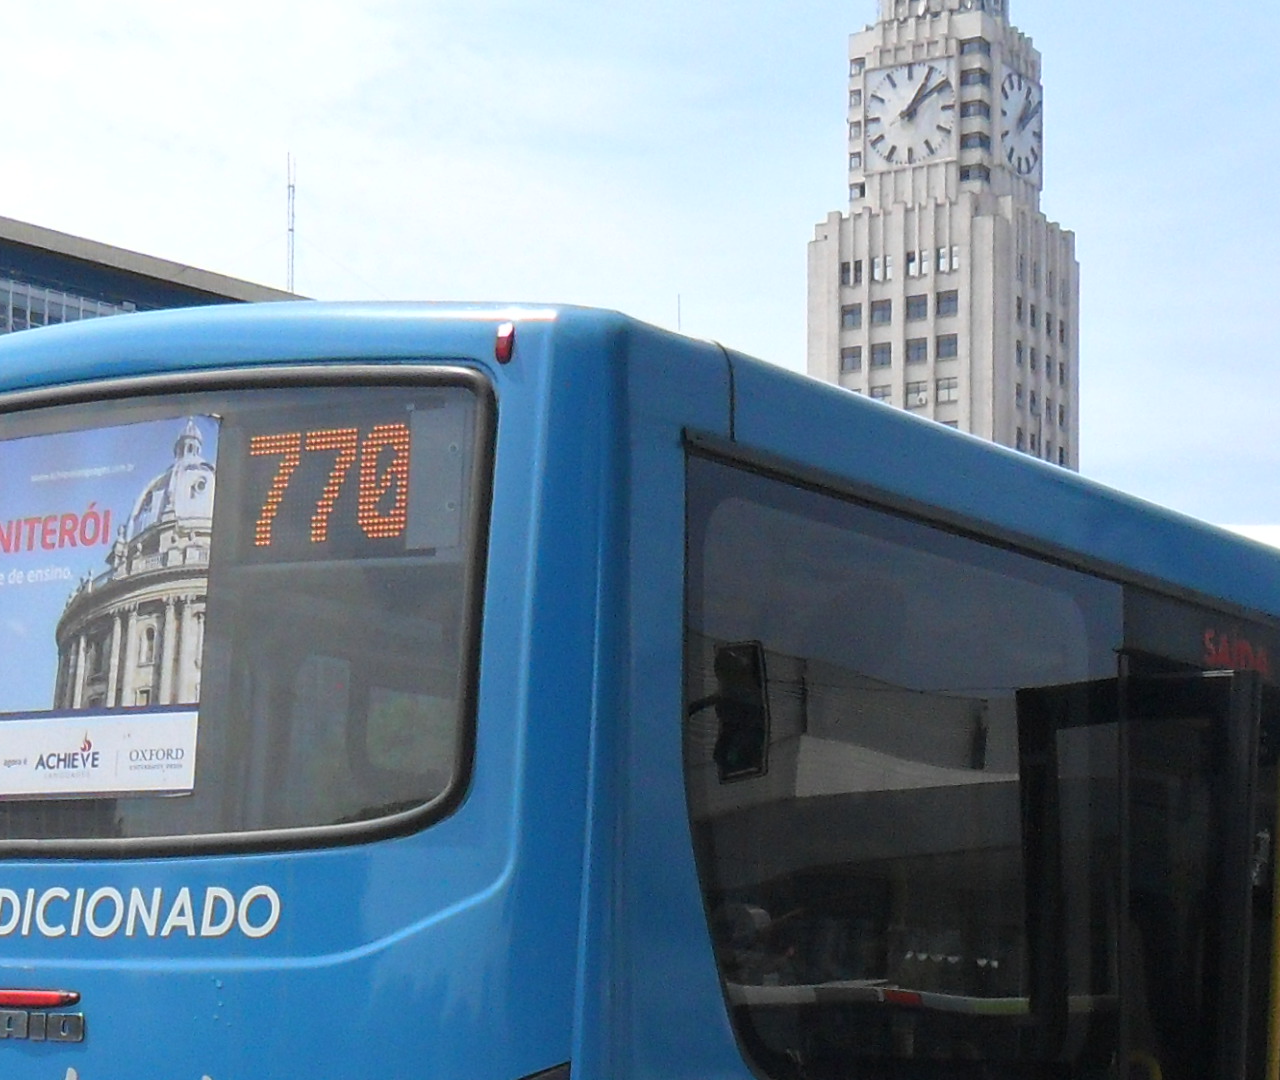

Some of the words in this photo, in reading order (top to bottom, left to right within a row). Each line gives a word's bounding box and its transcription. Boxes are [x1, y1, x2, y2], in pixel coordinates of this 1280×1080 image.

[250, 424, 410, 547] 770
[7, 568, 24, 584] de
[35, 751, 100, 771] ACHIEVE
[129, 748, 185, 763] OXFORD
